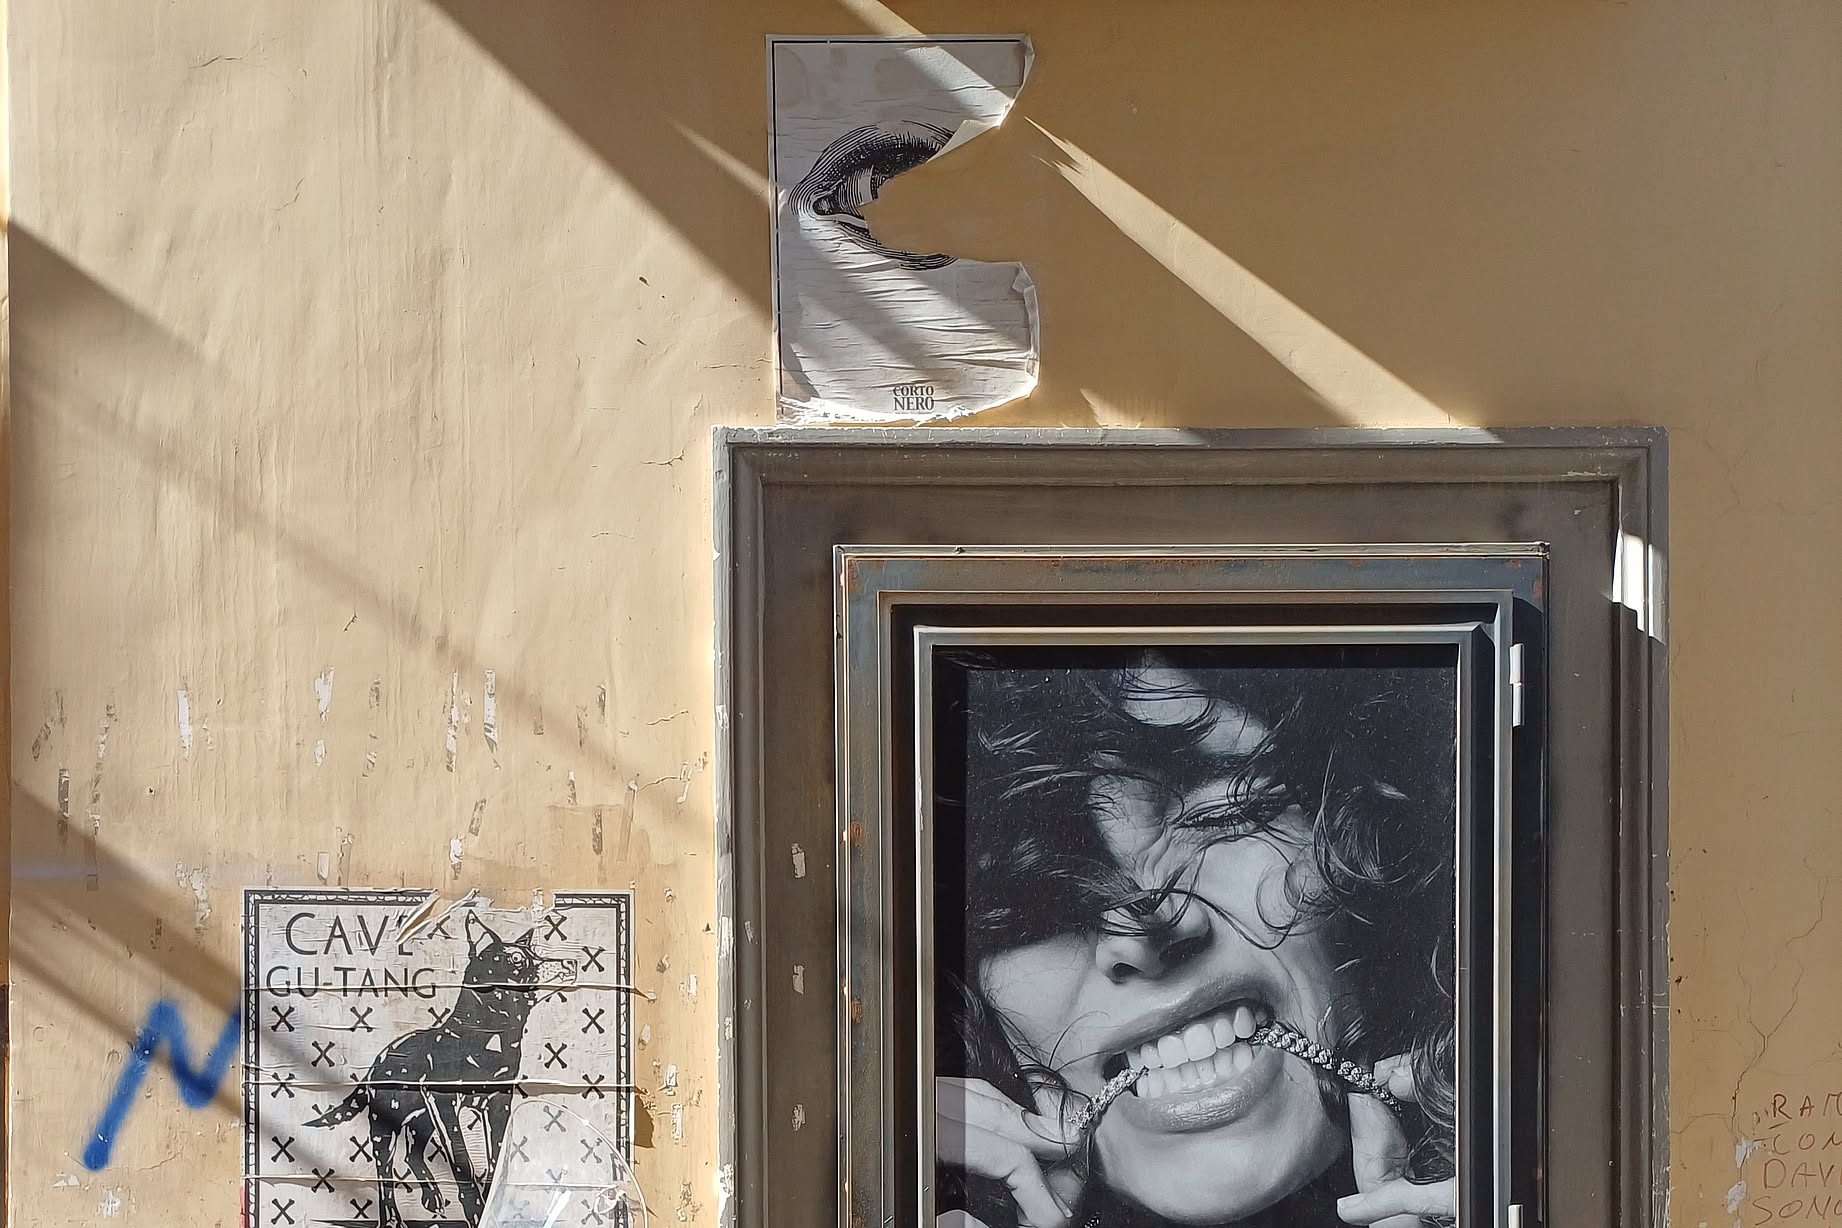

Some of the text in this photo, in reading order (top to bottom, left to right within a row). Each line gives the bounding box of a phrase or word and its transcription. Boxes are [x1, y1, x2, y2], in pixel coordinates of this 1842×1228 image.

[893, 385, 934, 396] CORTO
[894, 396, 935, 411] NERO
[266, 965, 436, 999] GU-TANG
[1763, 1158, 1842, 1189] DAV
